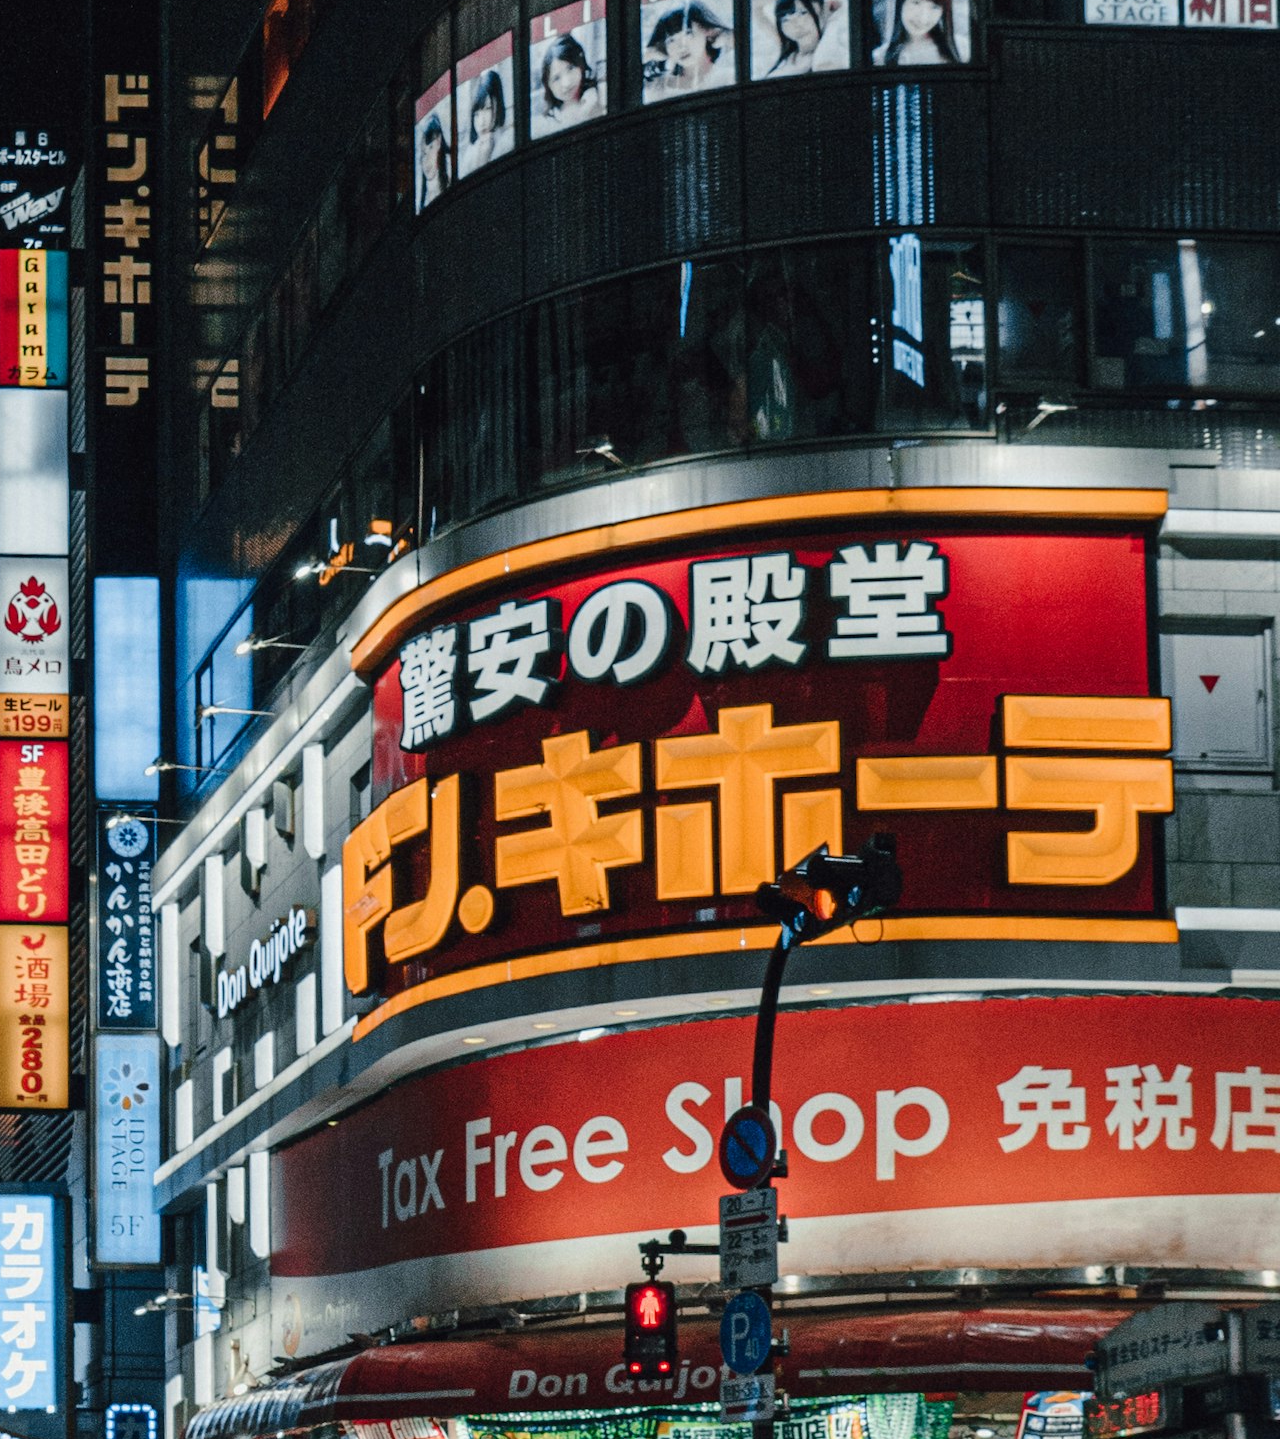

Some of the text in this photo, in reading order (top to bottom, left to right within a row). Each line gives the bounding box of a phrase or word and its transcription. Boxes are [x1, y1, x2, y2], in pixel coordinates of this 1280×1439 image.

[1095, 4, 1169, 23] STAGE
[20, 257, 45, 357] Garam
[7, 365, 58, 381] ガラム
[4, 658, 62, 677] 鳥メロ
[399, 539, 951, 753] 驚安の殿堂
[3, 697, 62, 712] 生ビール
[20, 744, 44, 763] 5F
[14, 956, 52, 1009] 酒場
[218, 908, 307, 1019] Don Quijote
[21, 1027, 43, 1095] 280
[997, 1065, 1280, 1157] 免税店
[111, 1118, 128, 1191] STAGE
[129, 1118, 146, 1178] IDOL
[378, 1144, 446, 1229] Tax
[463, 1109, 630, 1205] Free
[111, 1215, 144, 1236] 5F
[0, 1204, 47, 1400] カラオケ
[730, 1312, 752, 1363] P
[508, 1370, 589, 1400] Don
